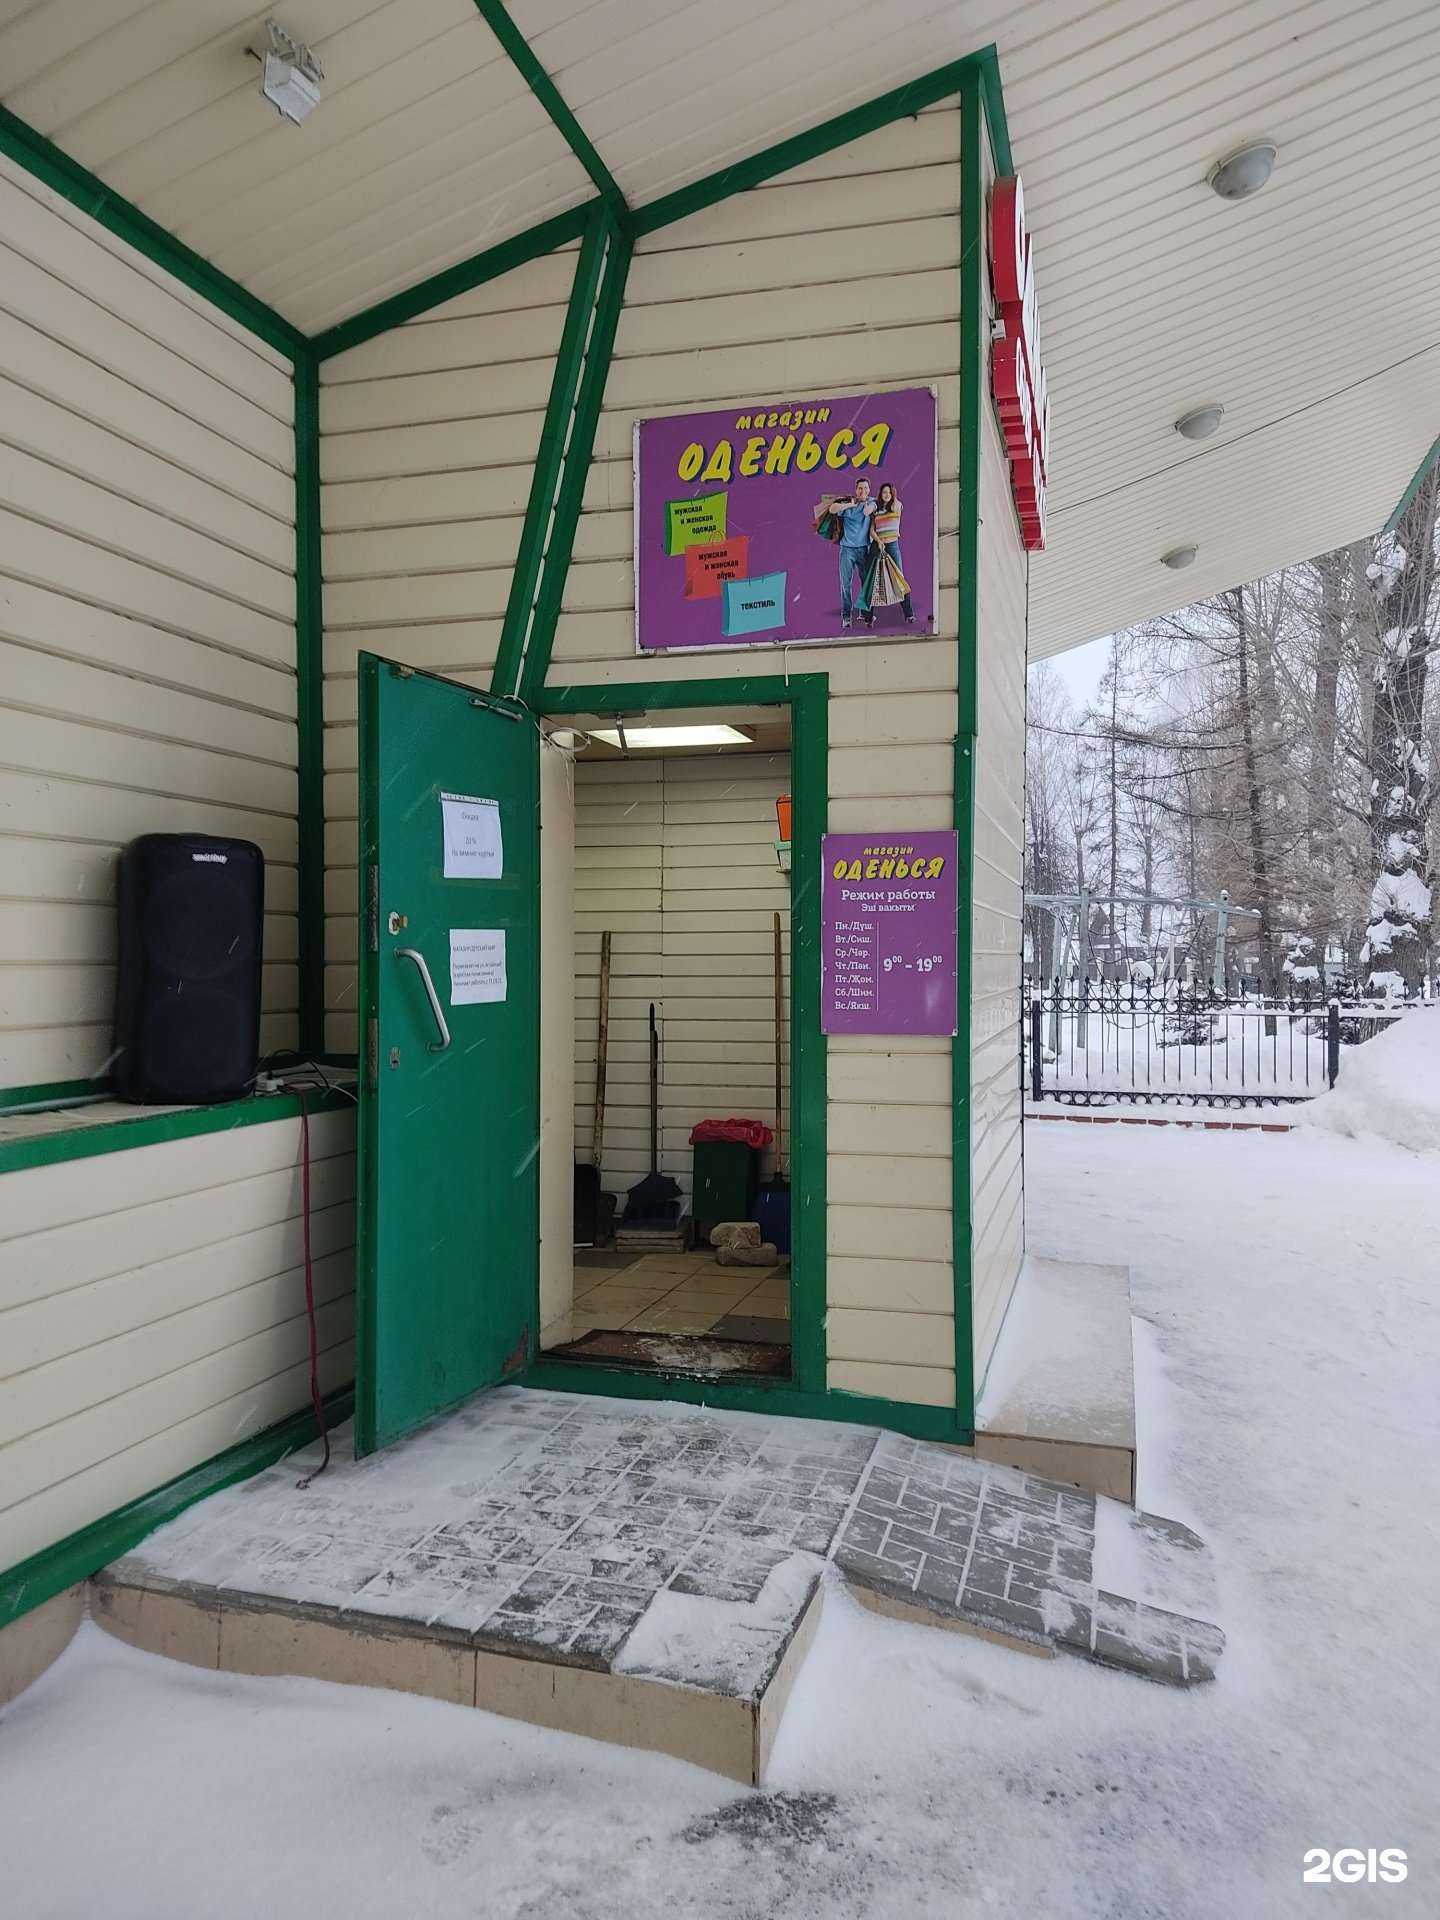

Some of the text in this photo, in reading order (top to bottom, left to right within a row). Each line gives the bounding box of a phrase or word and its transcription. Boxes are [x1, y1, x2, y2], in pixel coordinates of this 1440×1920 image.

[735, 406, 832, 431] магазин
[677, 422, 893, 484] ОДЕНЬСЯ
[674, 504, 703, 516] мужская
[686, 514, 714, 524] женская
[692, 524, 717, 535] одежда
[698, 550, 728, 561] мужская
[704, 560, 739, 571] и женская
[716, 571, 736, 581] обувь
[740, 599, 776, 611] текстиль
[863, 846, 915, 858] магазин
[833, 856, 945, 882] ОДЕНЬСЯ
[841, 889, 936, 903] Режим работы
[861, 903, 915, 913] Эш вакыты
